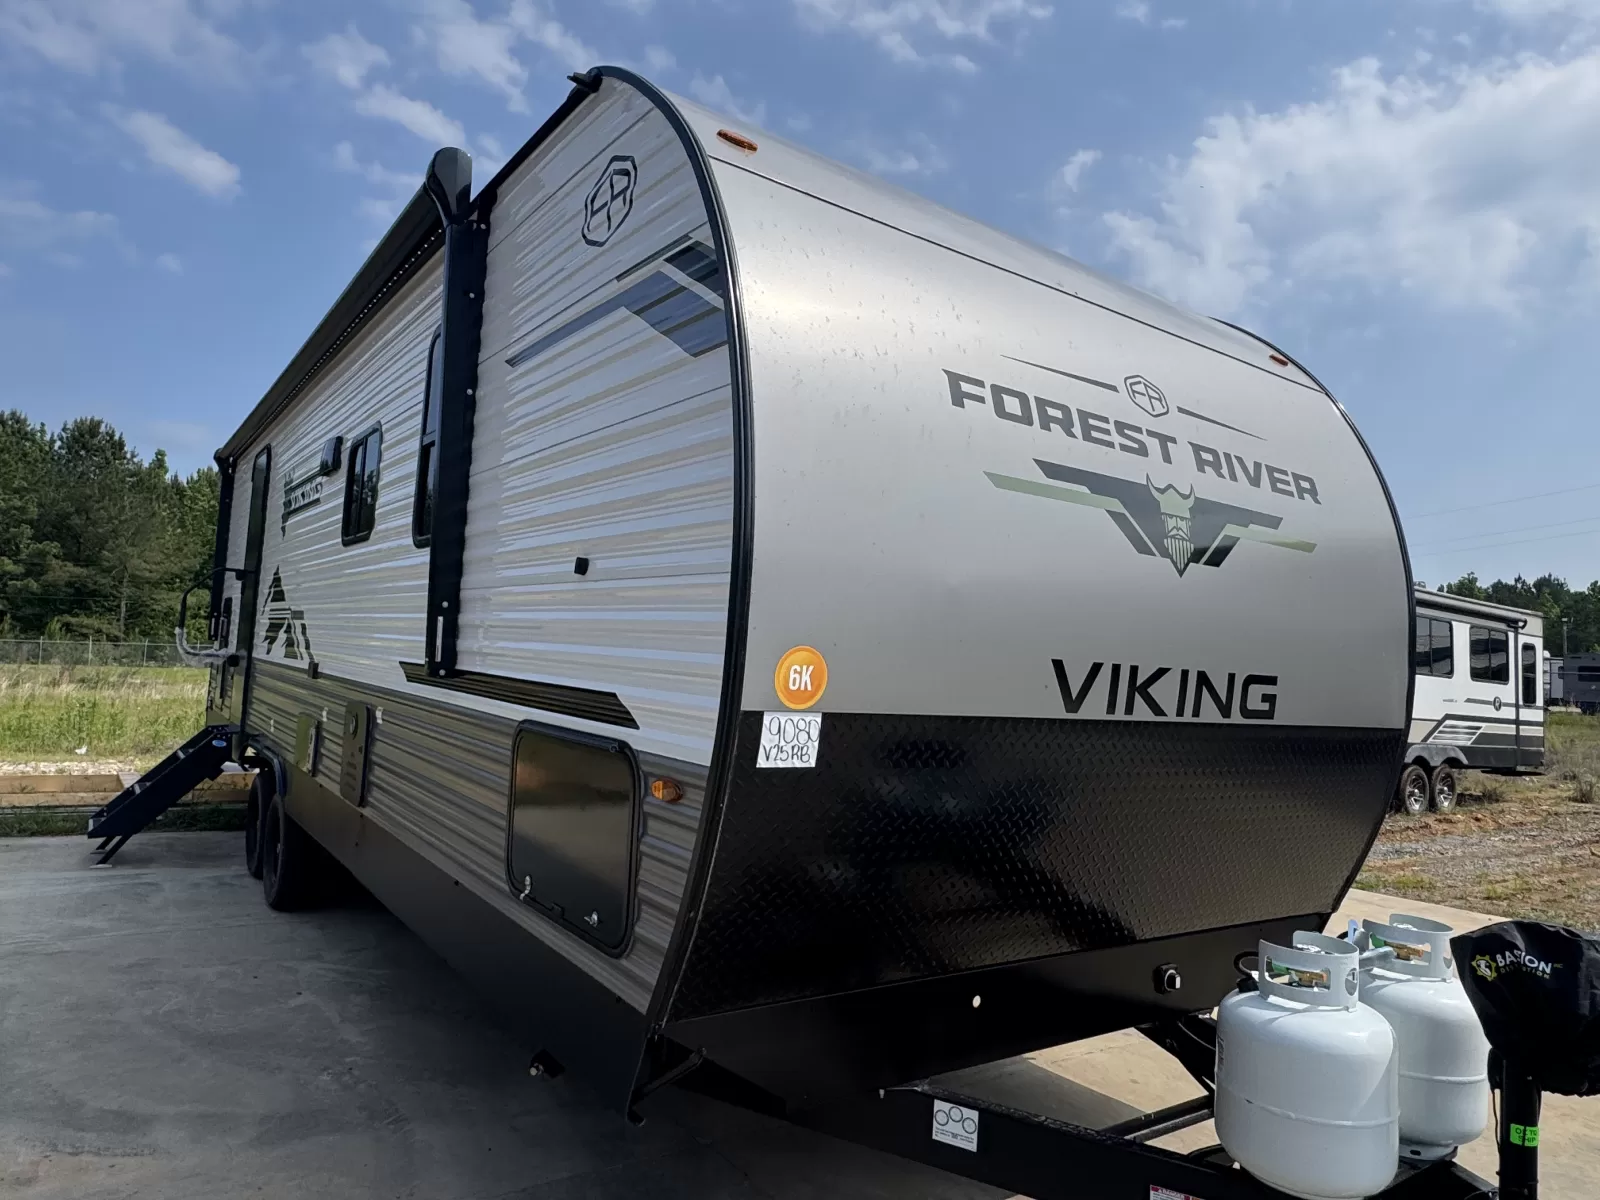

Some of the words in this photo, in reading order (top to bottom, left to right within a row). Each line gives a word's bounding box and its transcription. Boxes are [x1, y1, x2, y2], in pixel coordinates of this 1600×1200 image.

[942, 369, 1177, 465] FOREST
[1187, 441, 1322, 505] RIVER
[788, 664, 815, 691] 6K
[1051, 658, 1279, 720] VIKING
[769, 716, 820, 744] 9080
